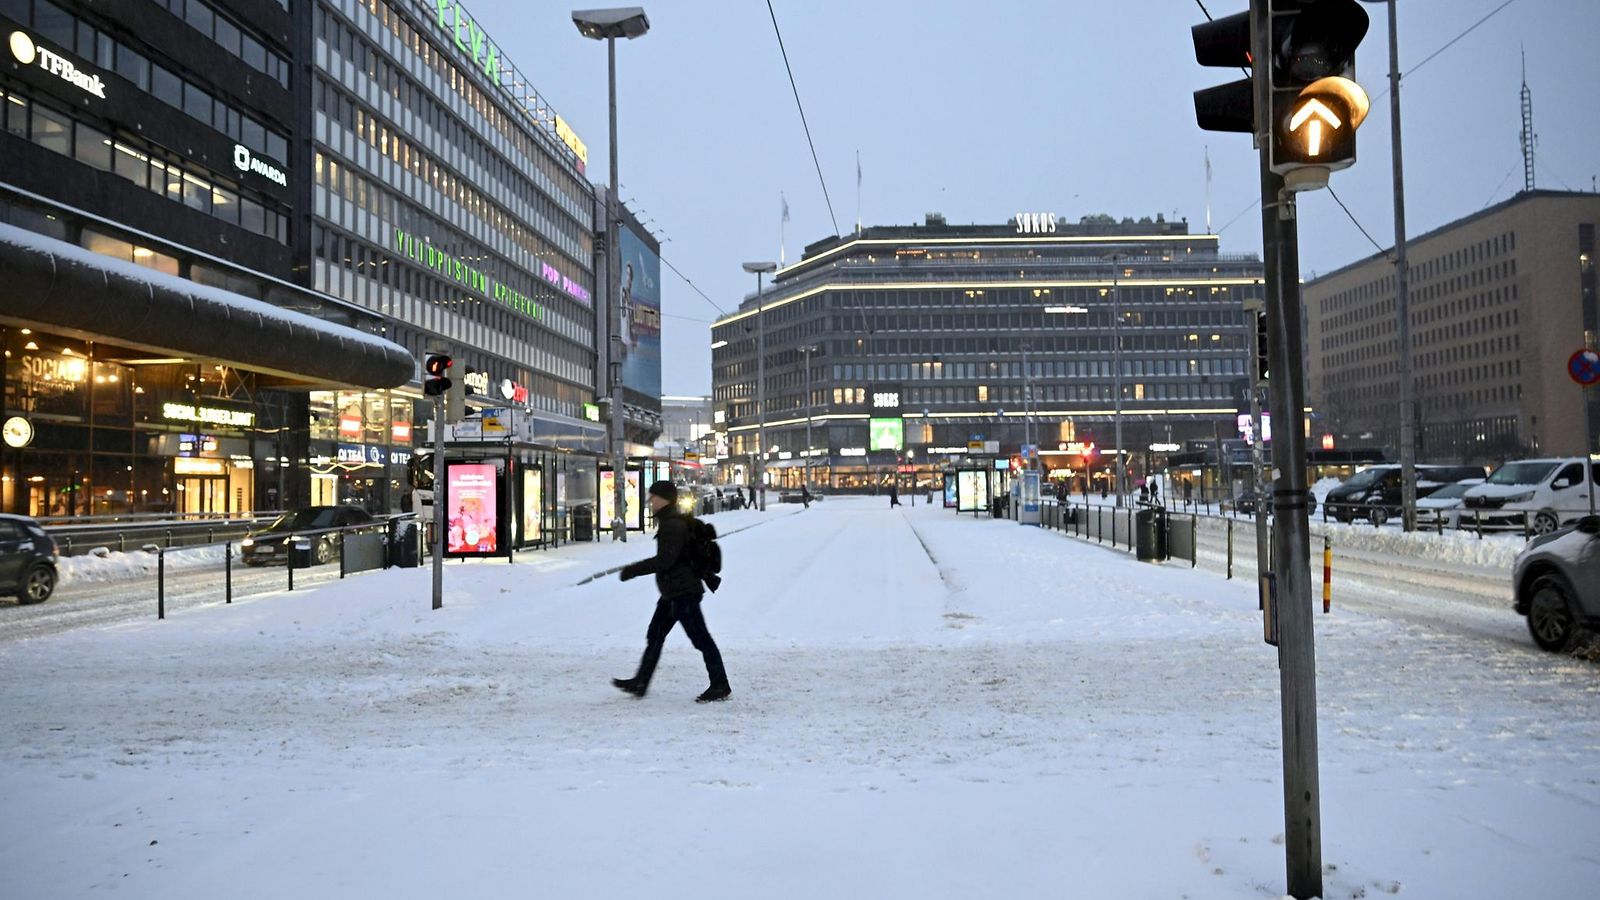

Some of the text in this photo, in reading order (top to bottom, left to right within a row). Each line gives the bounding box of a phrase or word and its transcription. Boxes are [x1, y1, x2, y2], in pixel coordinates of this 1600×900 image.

[250, 158, 287, 187] AVARDA
[1016, 212, 1056, 234] SOKOS
[396, 229, 543, 321] YLIOPISTON APTEEKKI
[542, 262, 559, 285] POP
[873, 393, 899, 407] SOKOS
